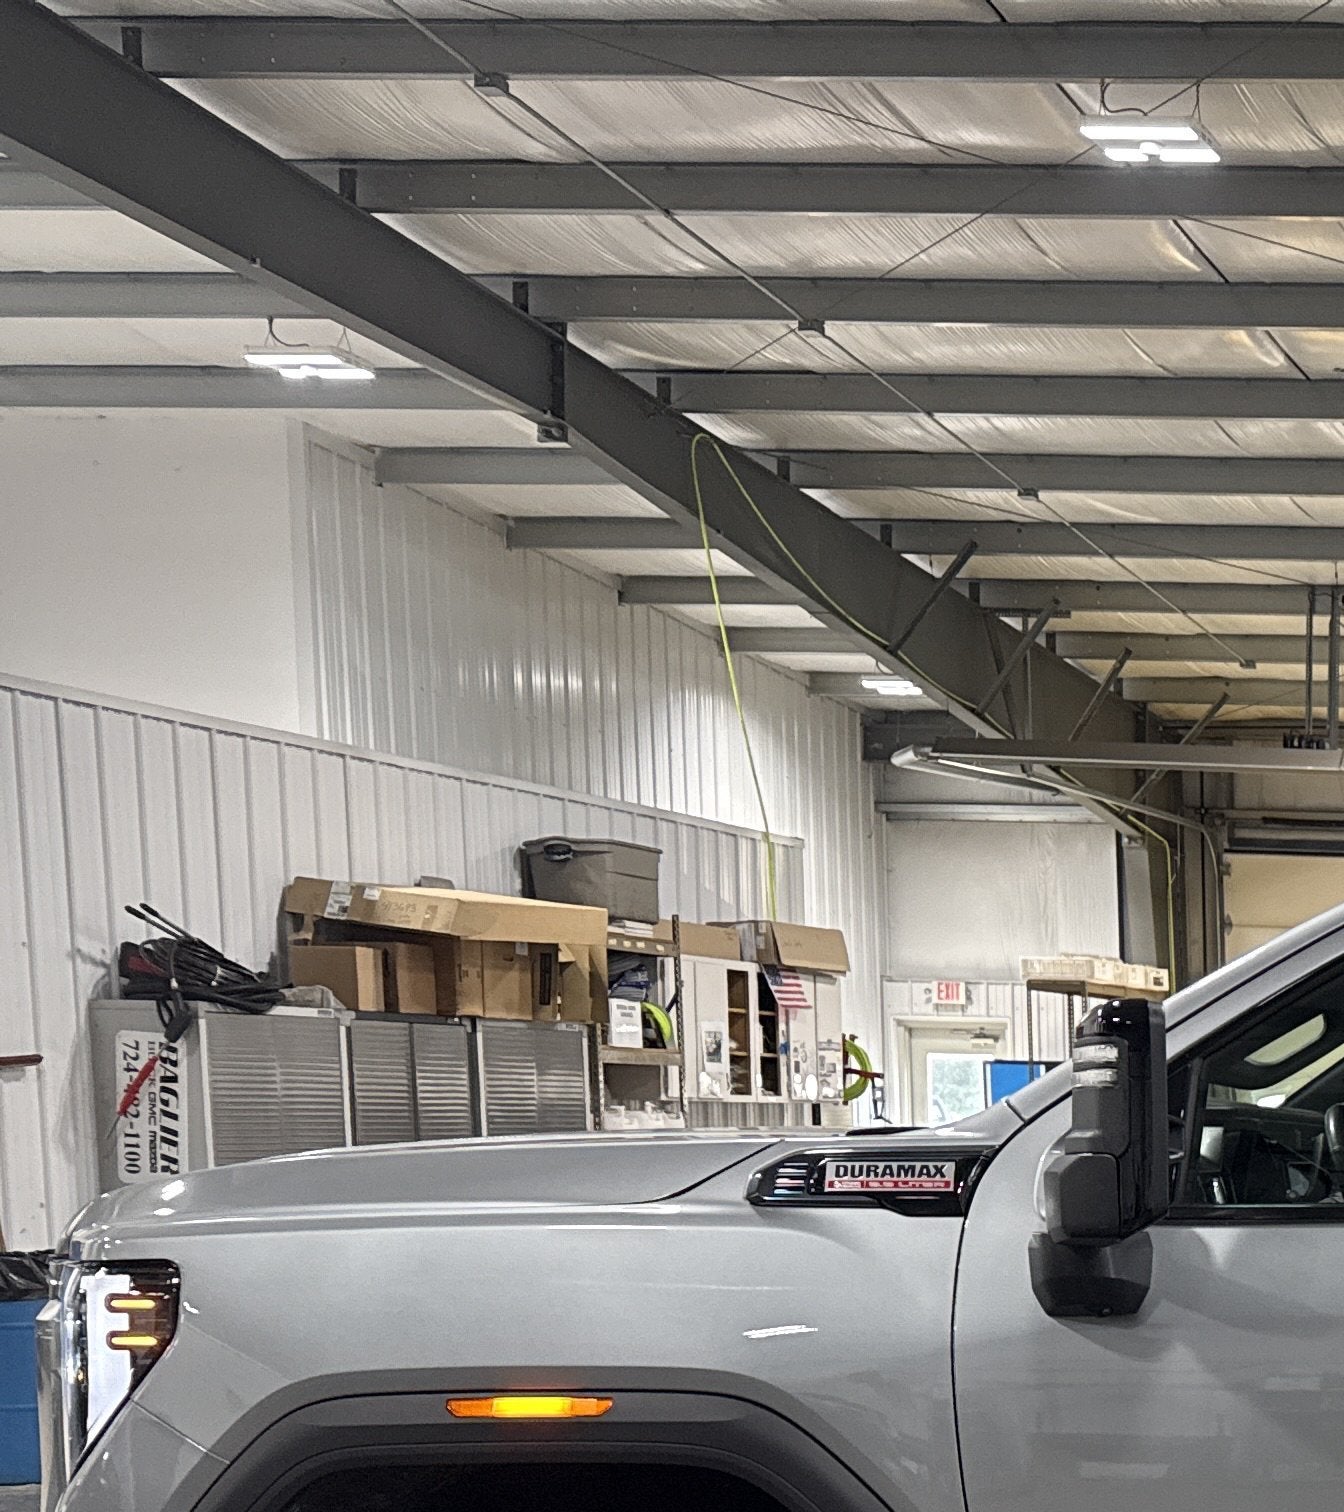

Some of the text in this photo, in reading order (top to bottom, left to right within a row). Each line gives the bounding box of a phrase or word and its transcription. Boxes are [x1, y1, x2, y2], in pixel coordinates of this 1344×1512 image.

[937, 981, 960, 1001] EXIT
[148, 1040, 158, 1174] BUK GMC mazda
[159, 1041, 179, 1174] BAGLIER
[834, 1164, 947, 1179] DURAMAX
